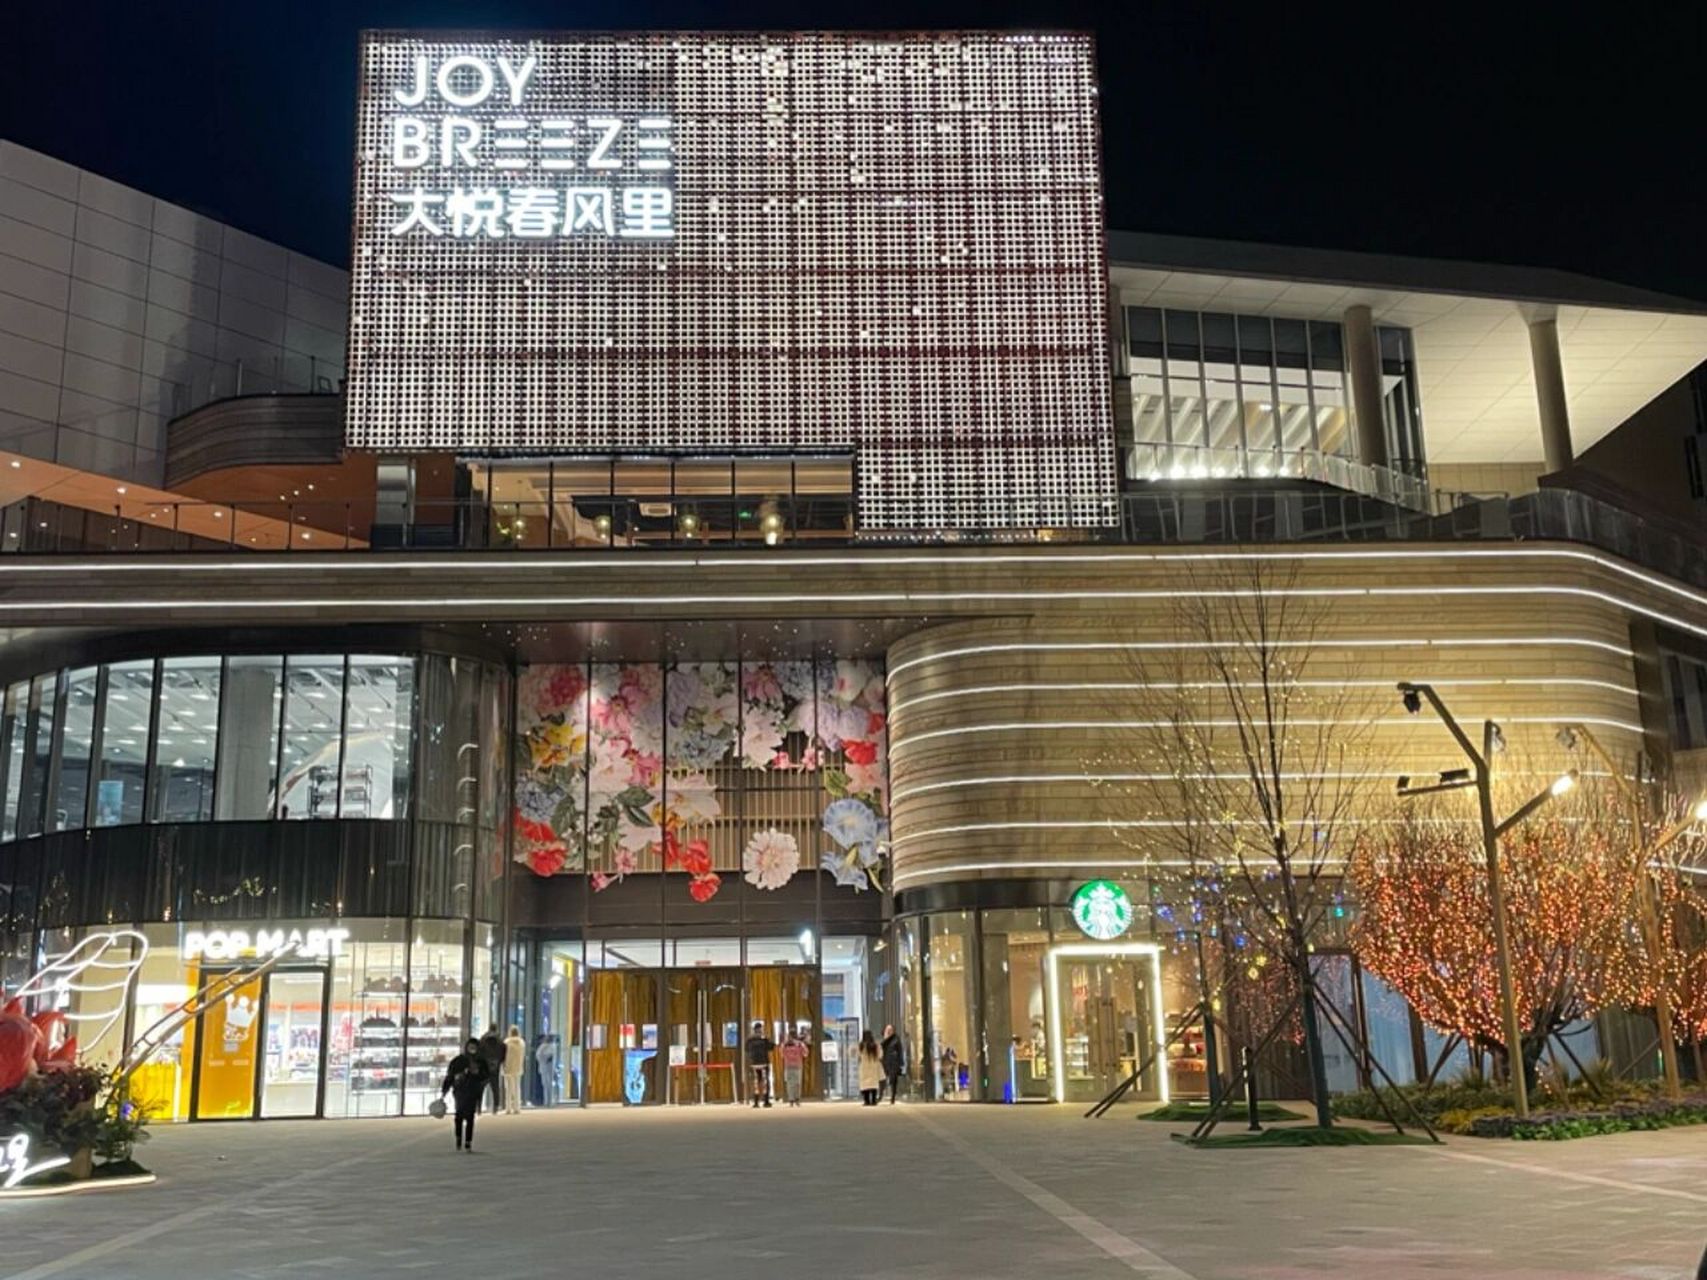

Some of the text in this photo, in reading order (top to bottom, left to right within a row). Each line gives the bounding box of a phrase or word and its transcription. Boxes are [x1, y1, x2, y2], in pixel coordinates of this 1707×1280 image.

[393, 55, 537, 106] JOY
[392, 117, 672, 169] BREEZE
[391, 187, 675, 237] 大悦春风里
[184, 928, 349, 959] POP MART
